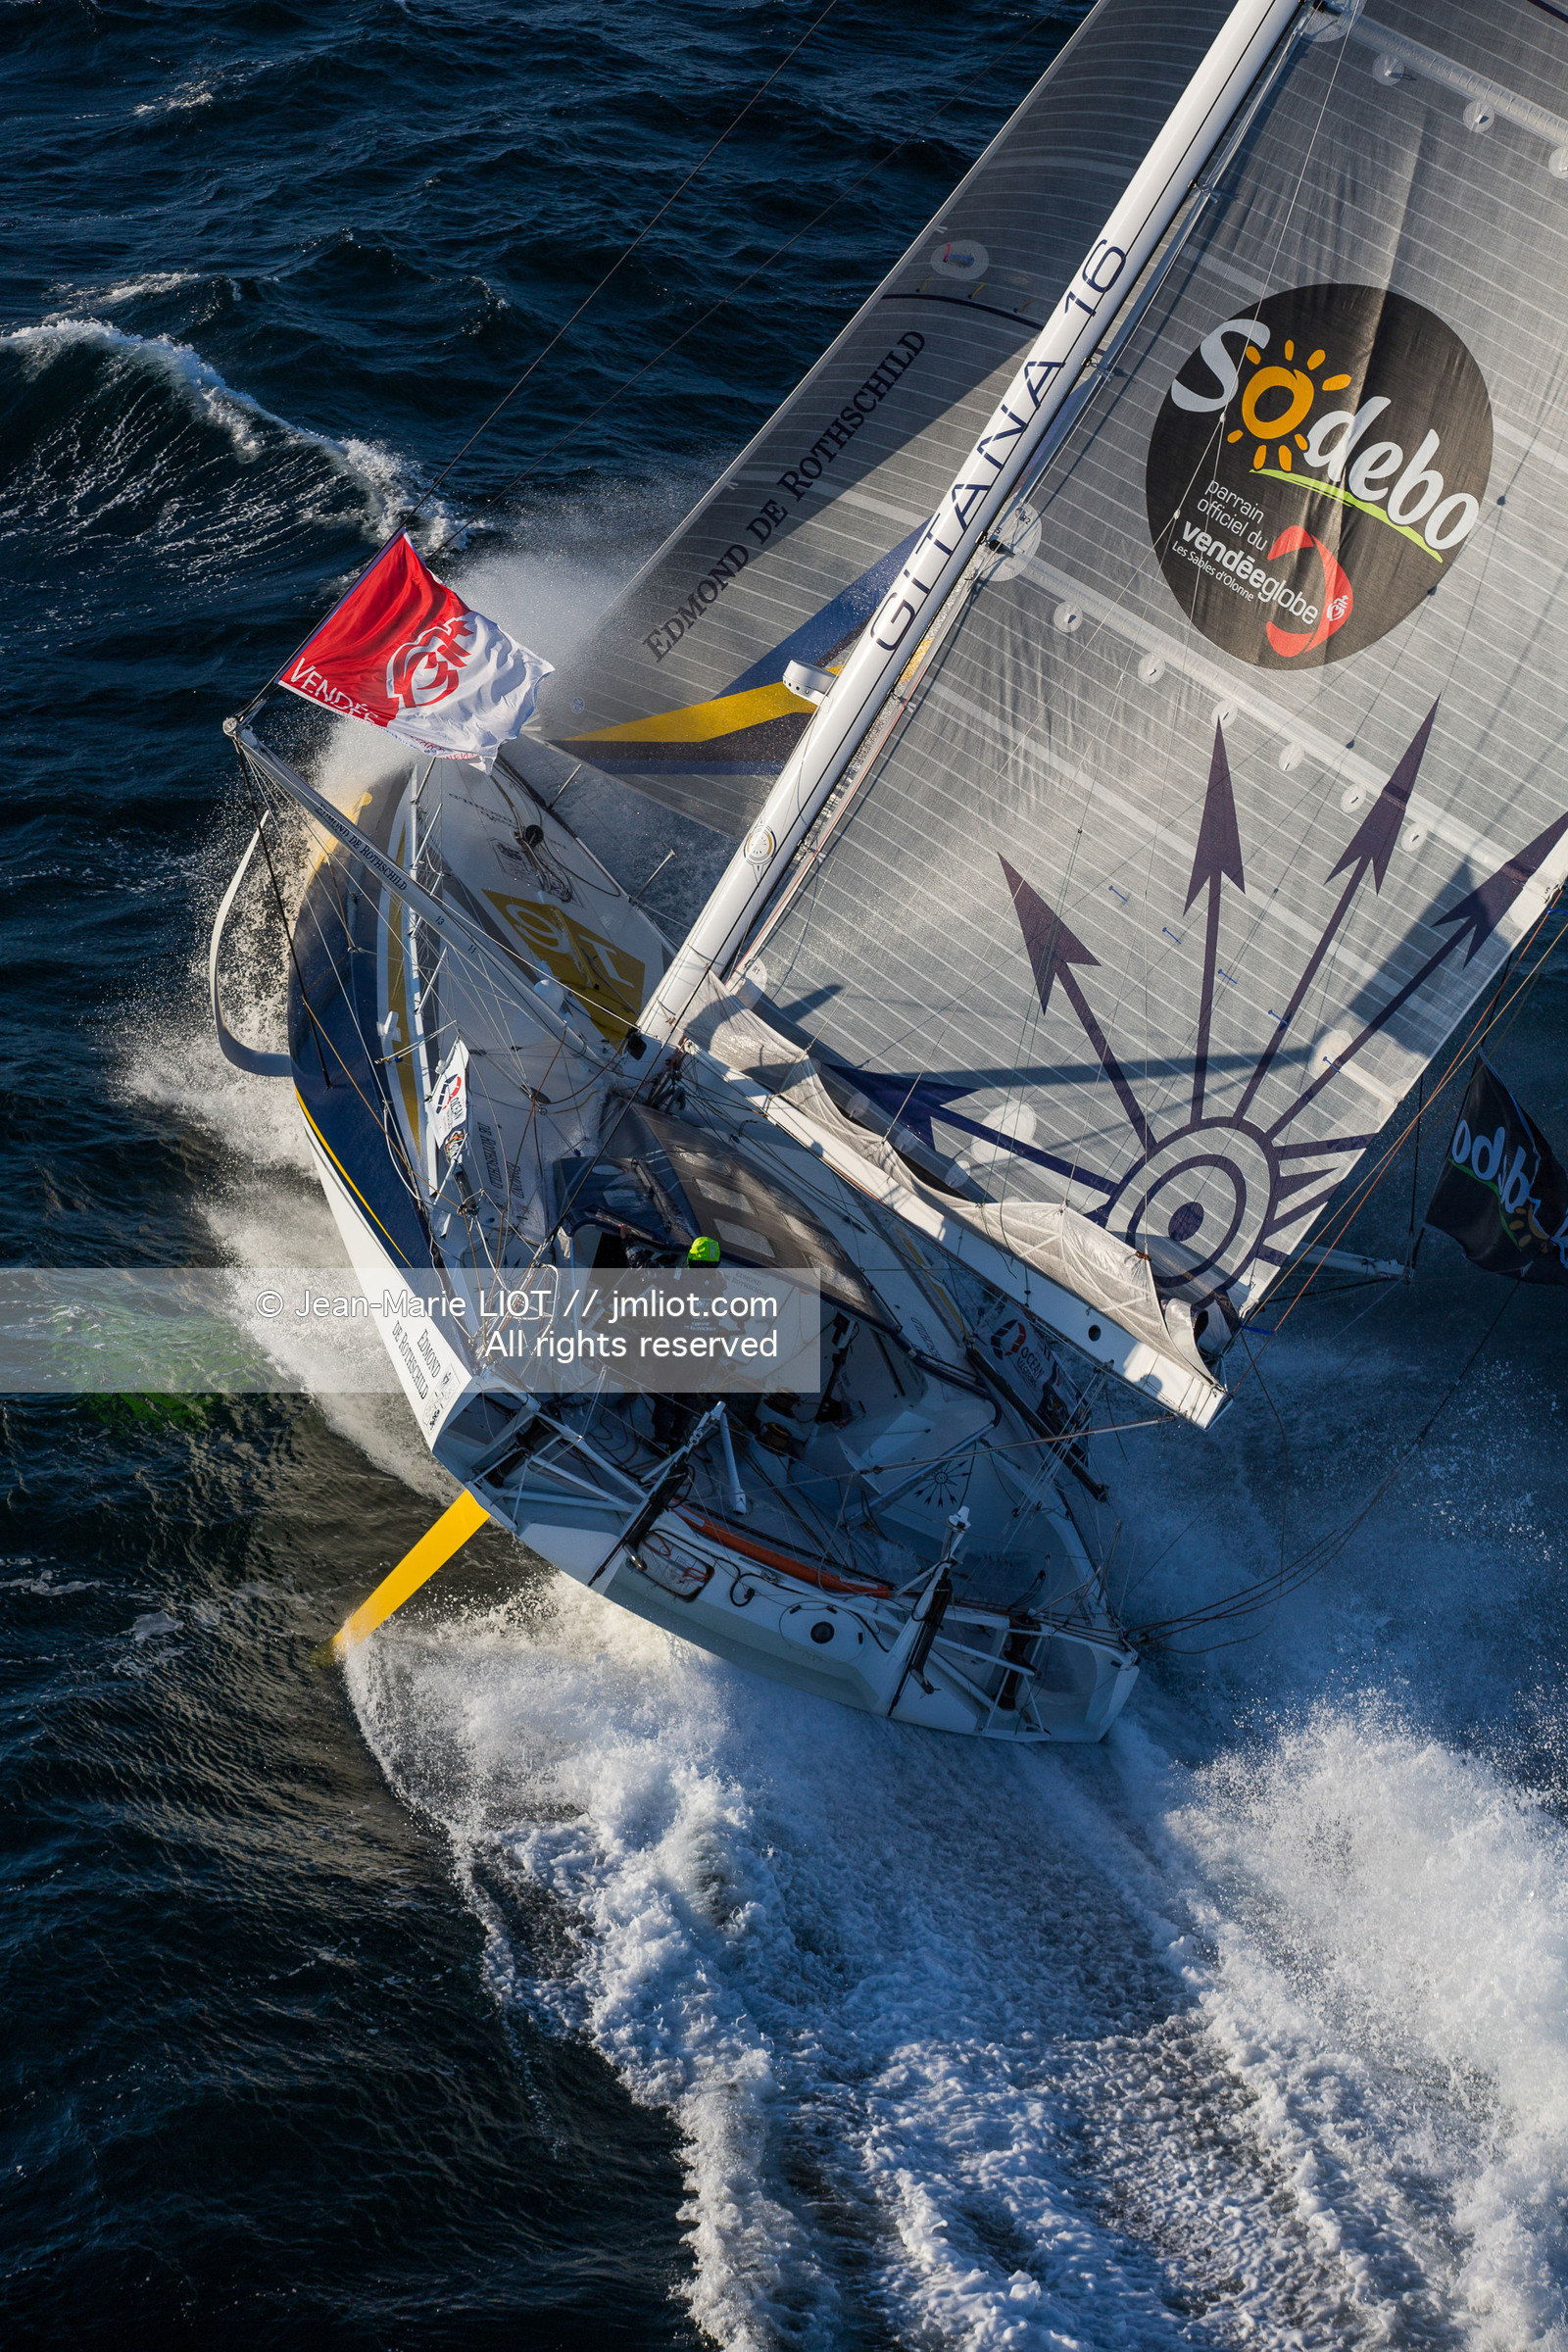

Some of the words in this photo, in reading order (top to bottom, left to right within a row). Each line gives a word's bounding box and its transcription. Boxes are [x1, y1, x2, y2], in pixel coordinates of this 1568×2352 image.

[869, 359, 1066, 652] GITANA
[1064, 238, 1126, 317] 16
[1171, 318, 1480, 550] Sodebo
[642, 541, 751, 663] EDMOND
[746, 499, 790, 545] DE
[776, 329, 926, 501] ROTHSCHILD
[1198, 498, 1249, 537] officiel
[1247, 530, 1267, 551] du
[1204, 480, 1264, 523] parrain
[1172, 541, 1186, 557] Les
[1187, 552, 1216, 576] Sables
[1215, 571, 1254, 602] d'Olonne
[349, 836, 361, 848] DE
[360, 845, 408, 891] ROTHSCHILD
[435, 915, 445, 925] 13
[392, 1320, 403, 1342] DE
[398, 1333, 429, 1400] ROTHSCHILD
[416, 1329, 441, 1378] EDMOND
